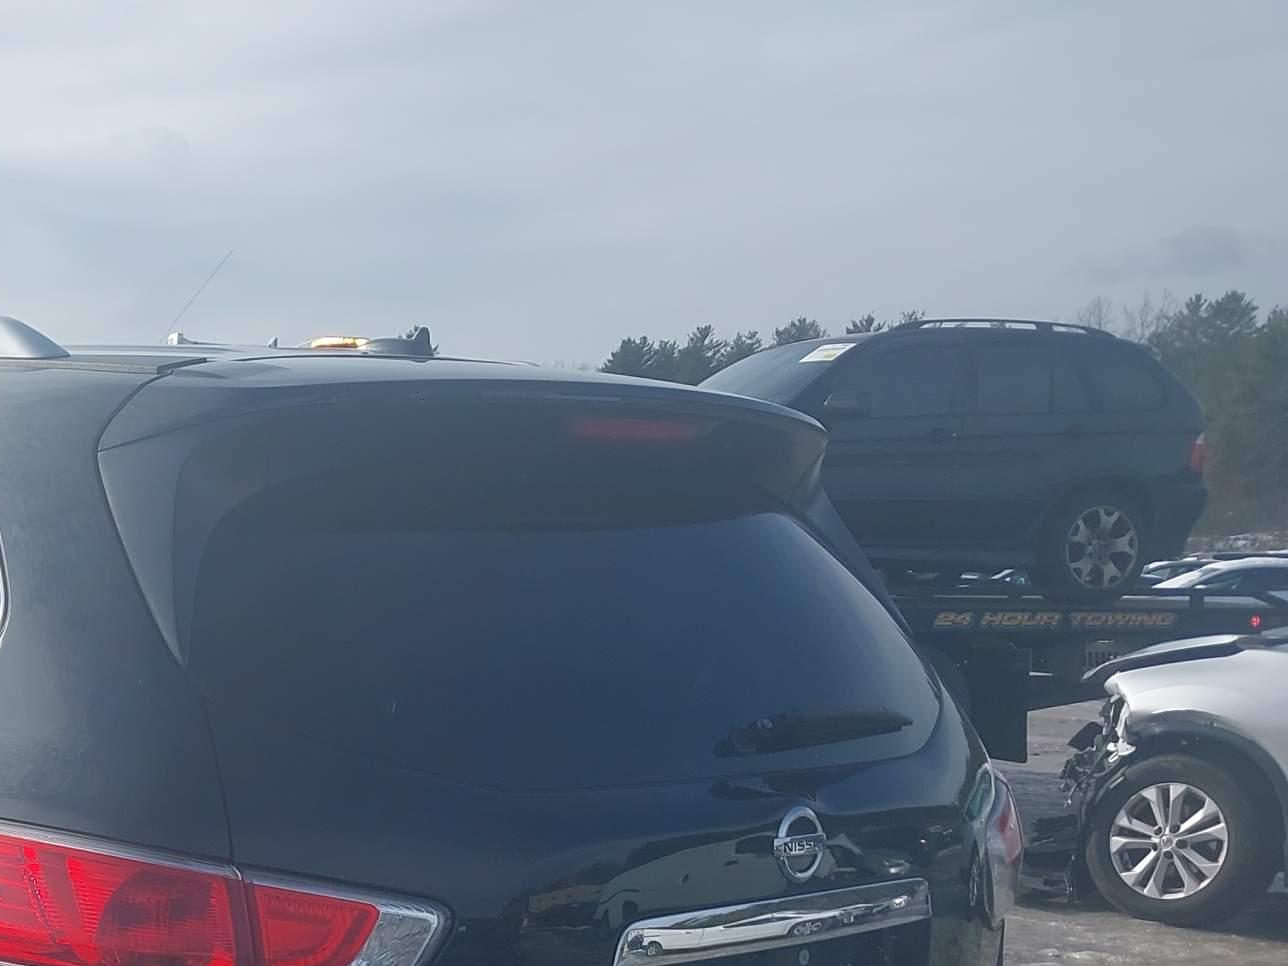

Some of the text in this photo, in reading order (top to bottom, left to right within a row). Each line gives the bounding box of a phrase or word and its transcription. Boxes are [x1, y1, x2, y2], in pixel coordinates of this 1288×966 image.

[935, 612, 1176, 627] 24 HOUR TOWING
